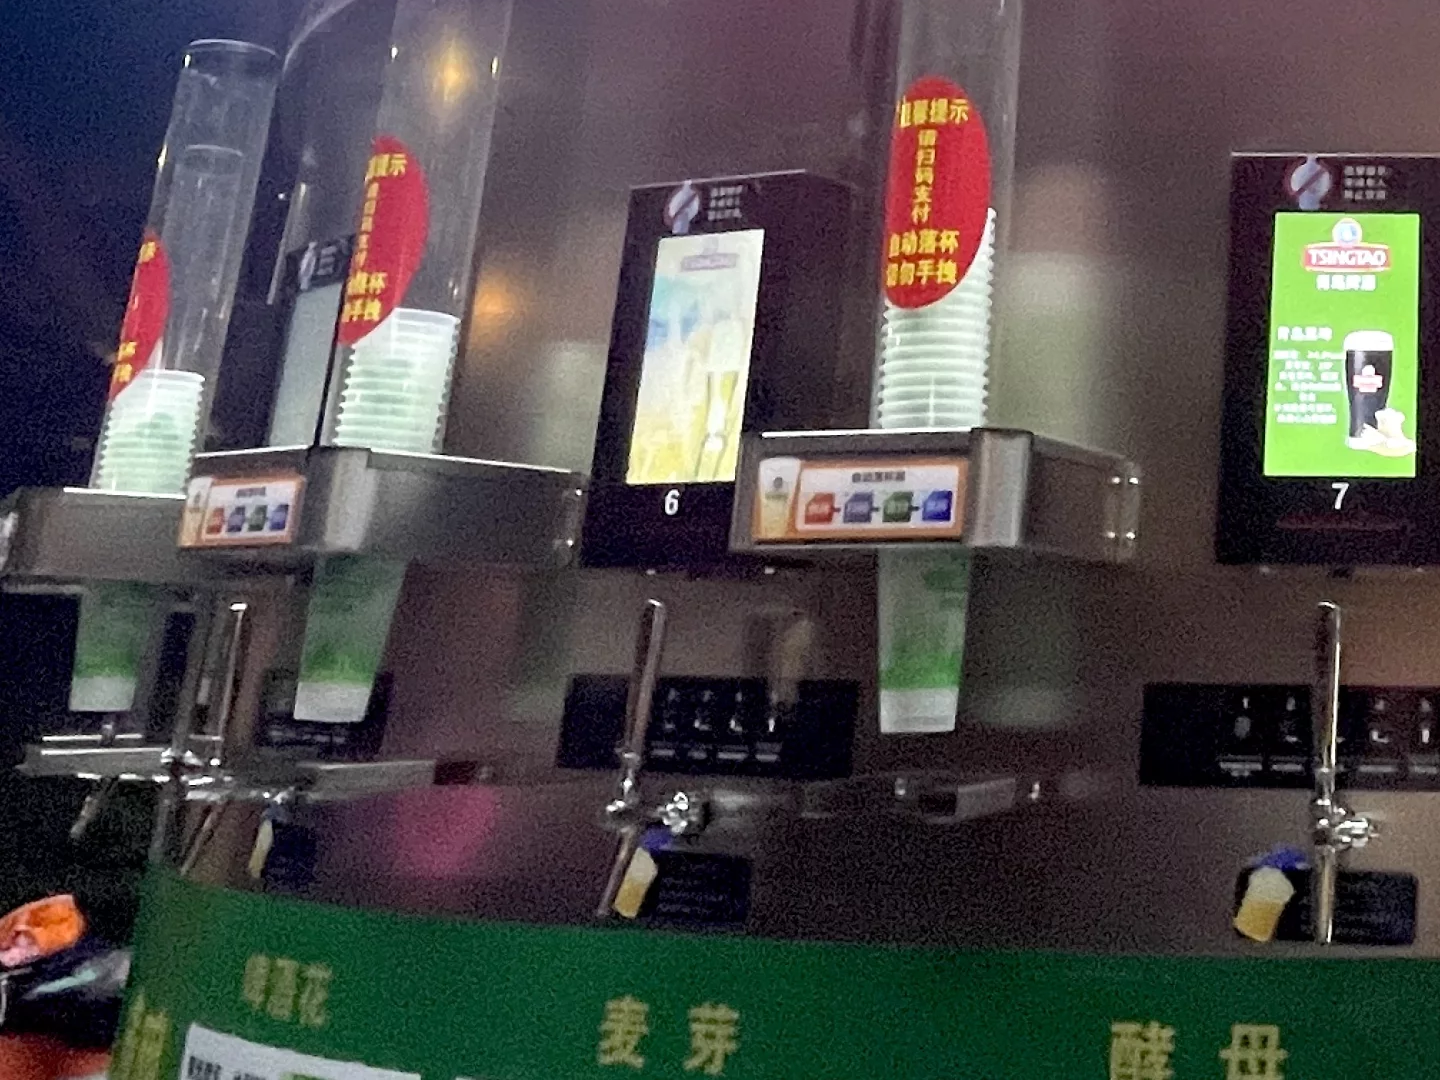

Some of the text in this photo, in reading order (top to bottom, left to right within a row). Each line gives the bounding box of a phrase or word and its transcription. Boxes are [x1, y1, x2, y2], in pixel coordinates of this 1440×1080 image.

[1307, 247, 1387, 267] TSINGTAO
[664, 489, 681, 516] 6
[1331, 482, 1350, 511] 7
[598, 995, 741, 1076] 麦芽
[1109, 1021, 1290, 1080] 酵母
